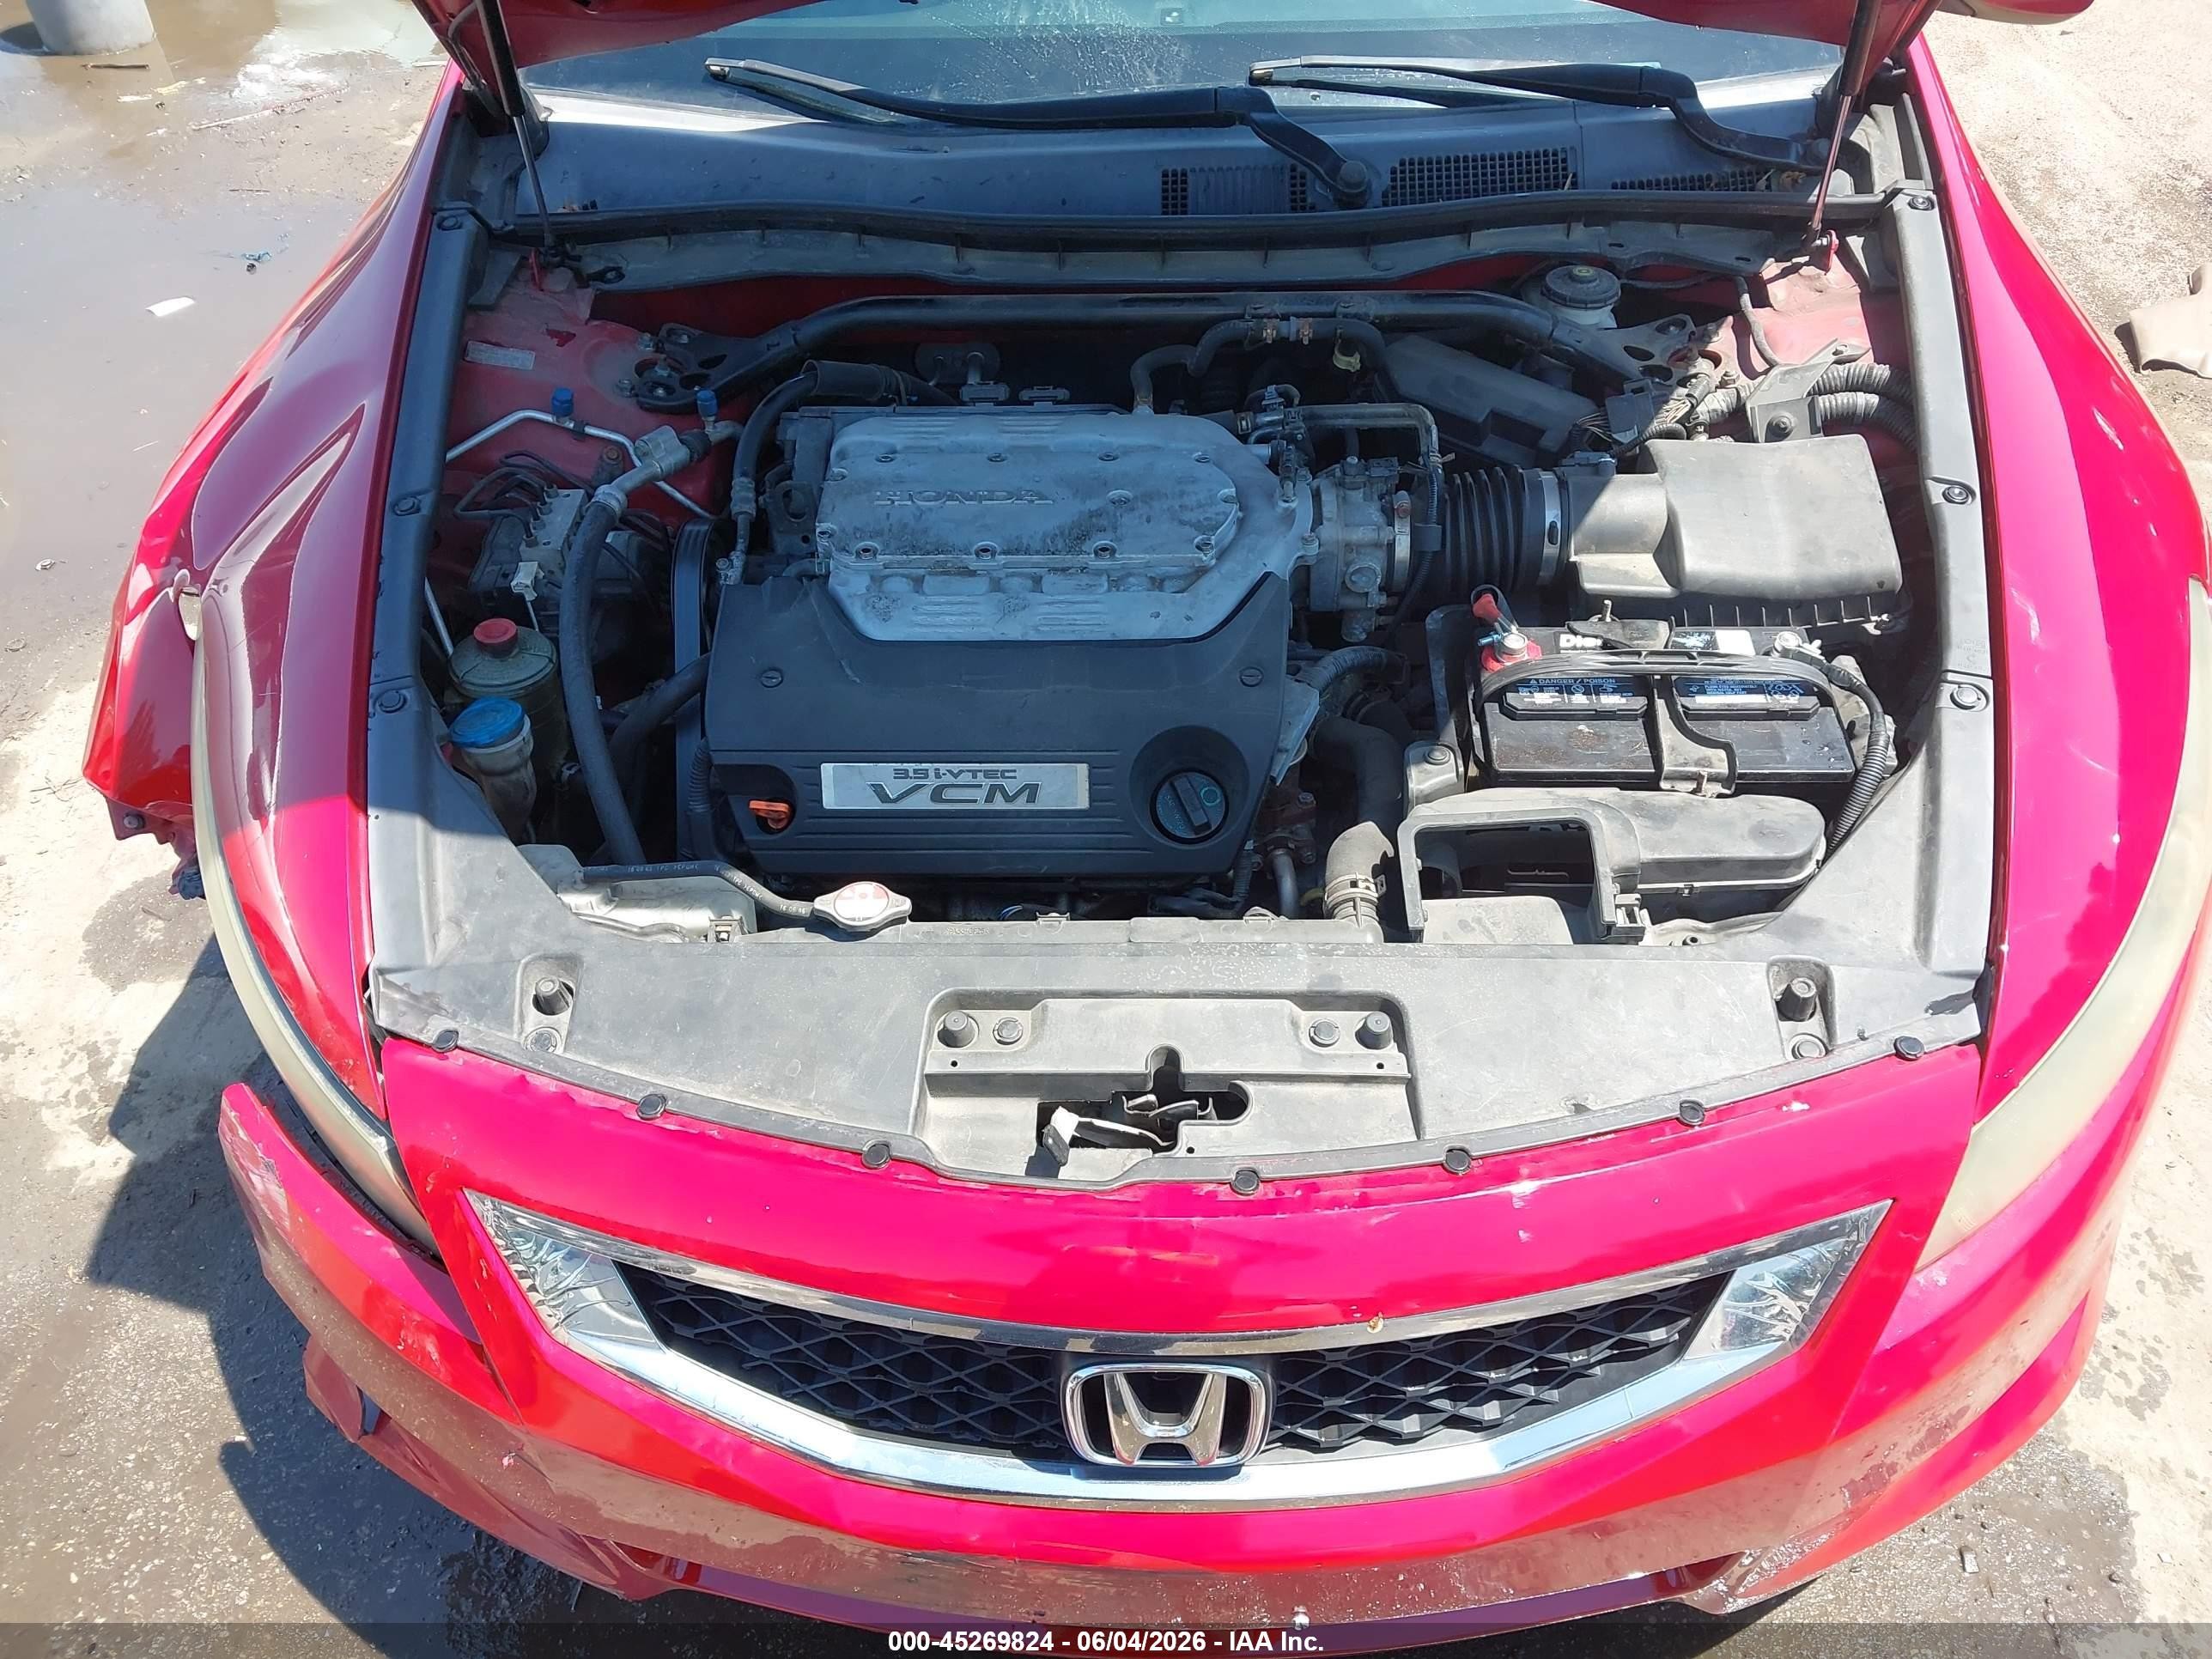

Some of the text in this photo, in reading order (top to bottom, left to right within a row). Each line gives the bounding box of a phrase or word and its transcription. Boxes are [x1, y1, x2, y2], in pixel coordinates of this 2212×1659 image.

[873, 489, 1053, 505] HONDA
[892, 767, 1018, 780] 3.5 i-VTEC
[866, 781, 1042, 805] VCM
